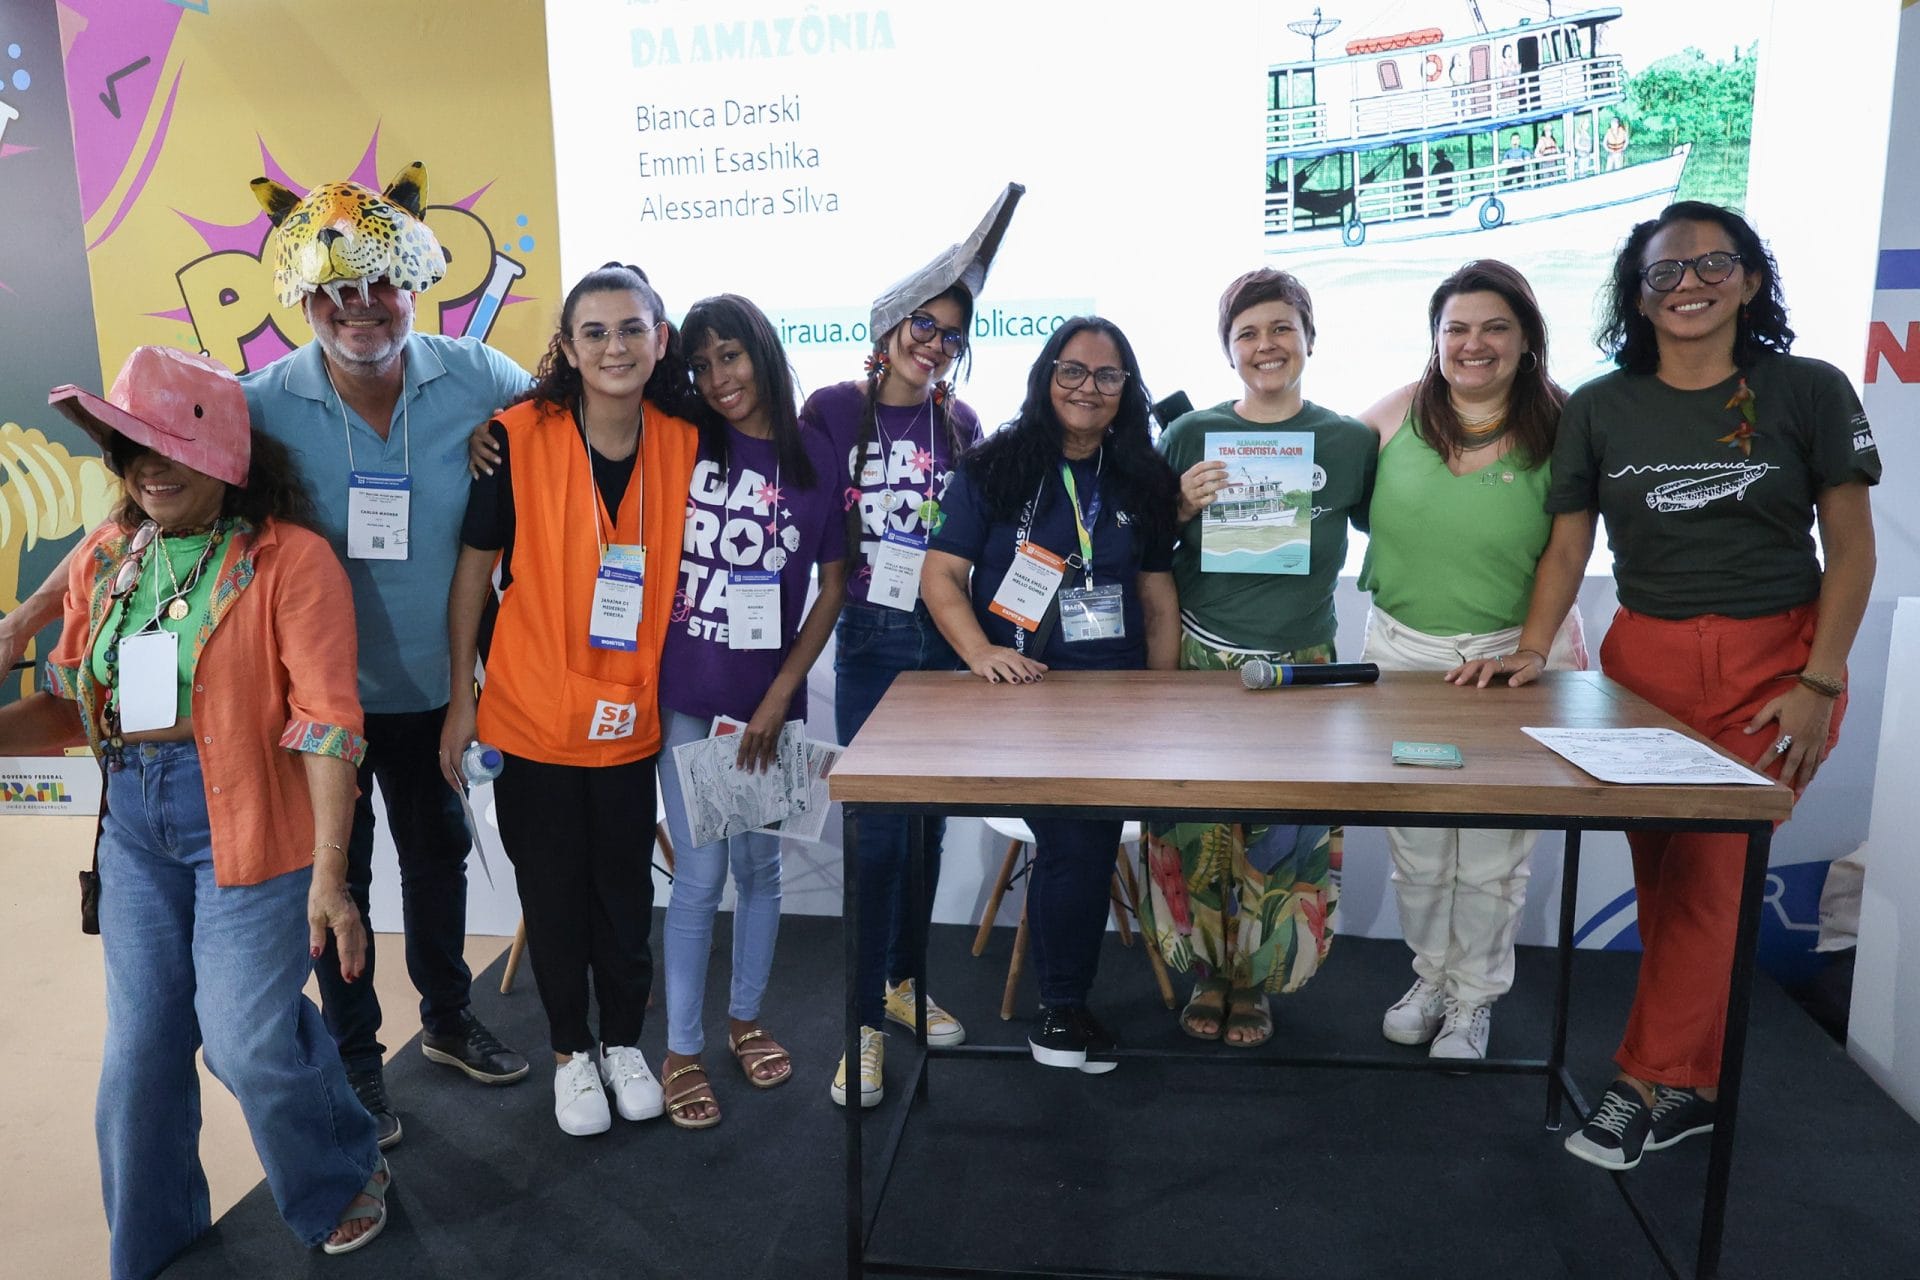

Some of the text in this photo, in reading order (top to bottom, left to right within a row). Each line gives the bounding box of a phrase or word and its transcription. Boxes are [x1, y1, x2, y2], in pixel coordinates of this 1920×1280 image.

[629, 4, 896, 68] DA AMAZÔNIA
[637, 94, 800, 131] Bianca Darski
[639, 141, 819, 177] Emmi Esashika
[640, 186, 839, 221] Alessandra Silva
[780, 308, 1066, 344] iraua.o blicaco
[1219, 447, 1236, 456] TEM
[1237, 447, 1277, 456] CIENTISTA
[689, 459, 770, 516] GA
[684, 507, 764, 566] RO
[687, 616, 729, 643] STE
[0, 782, 71, 802] BRASIL
